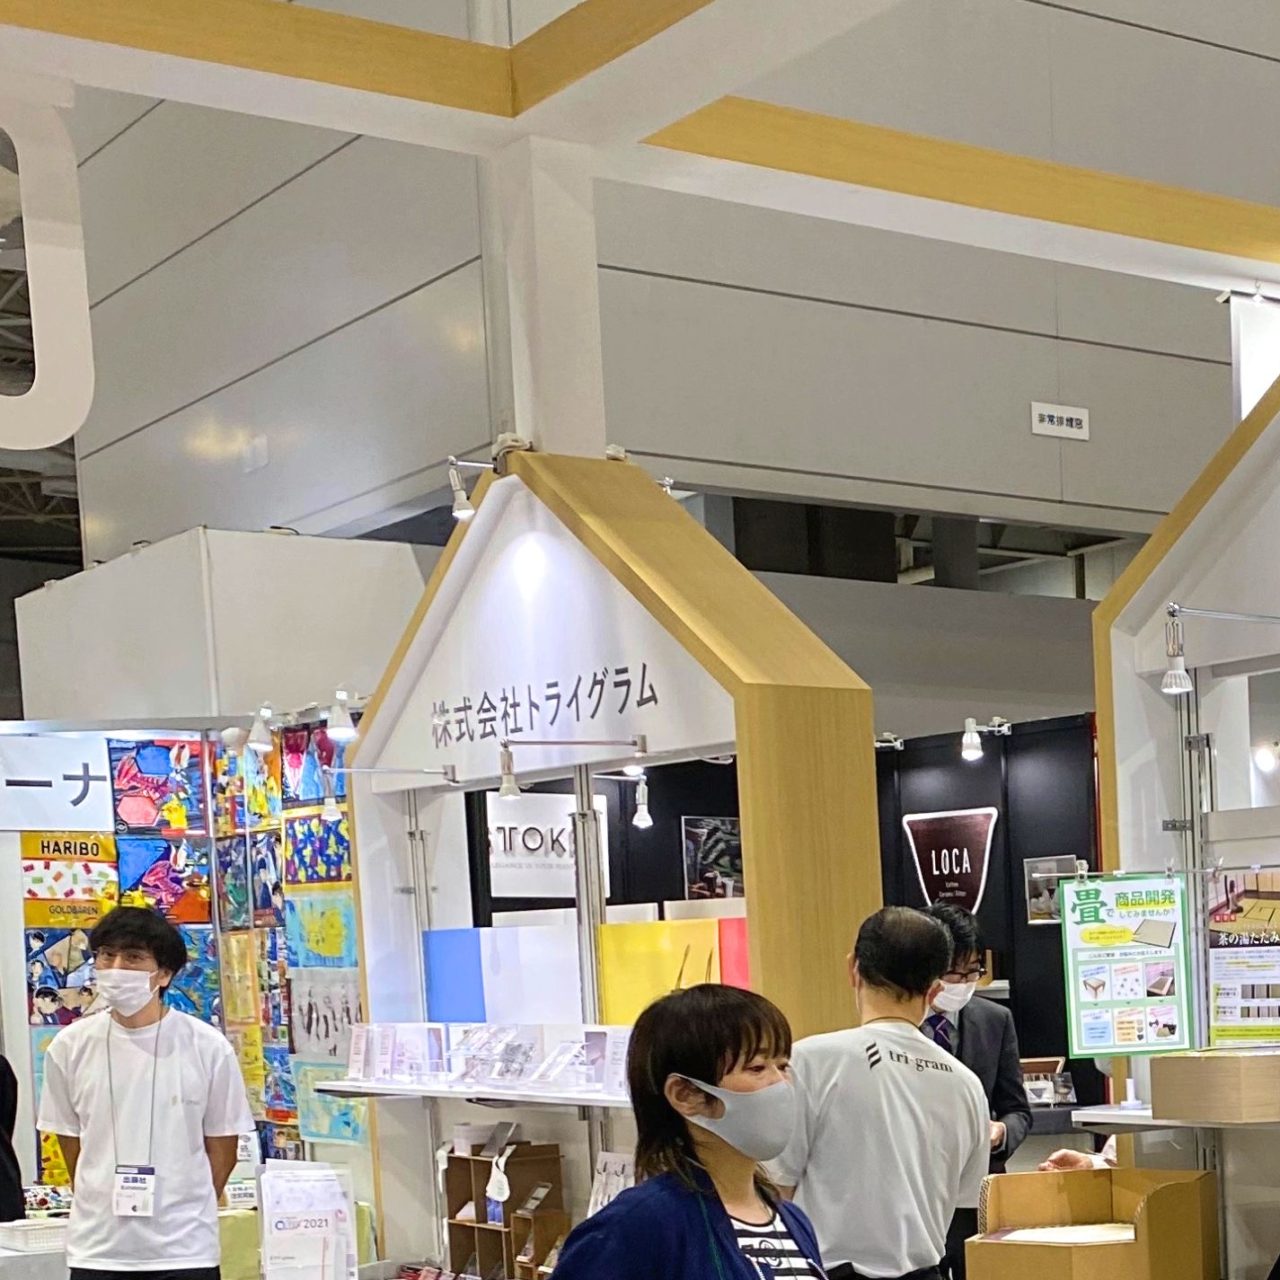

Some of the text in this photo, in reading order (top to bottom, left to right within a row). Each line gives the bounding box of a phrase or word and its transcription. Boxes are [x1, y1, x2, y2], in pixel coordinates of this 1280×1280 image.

[431, 662, 659, 749] 株式会社トライグラム
[40, 840, 100, 857] HARIBO
[931, 847, 971, 876] LOCA
[1115, 888, 1176, 908] 商品開発
[888, 1050, 953, 1072] tri-gram
[303, 1219, 329, 1229] 2021
